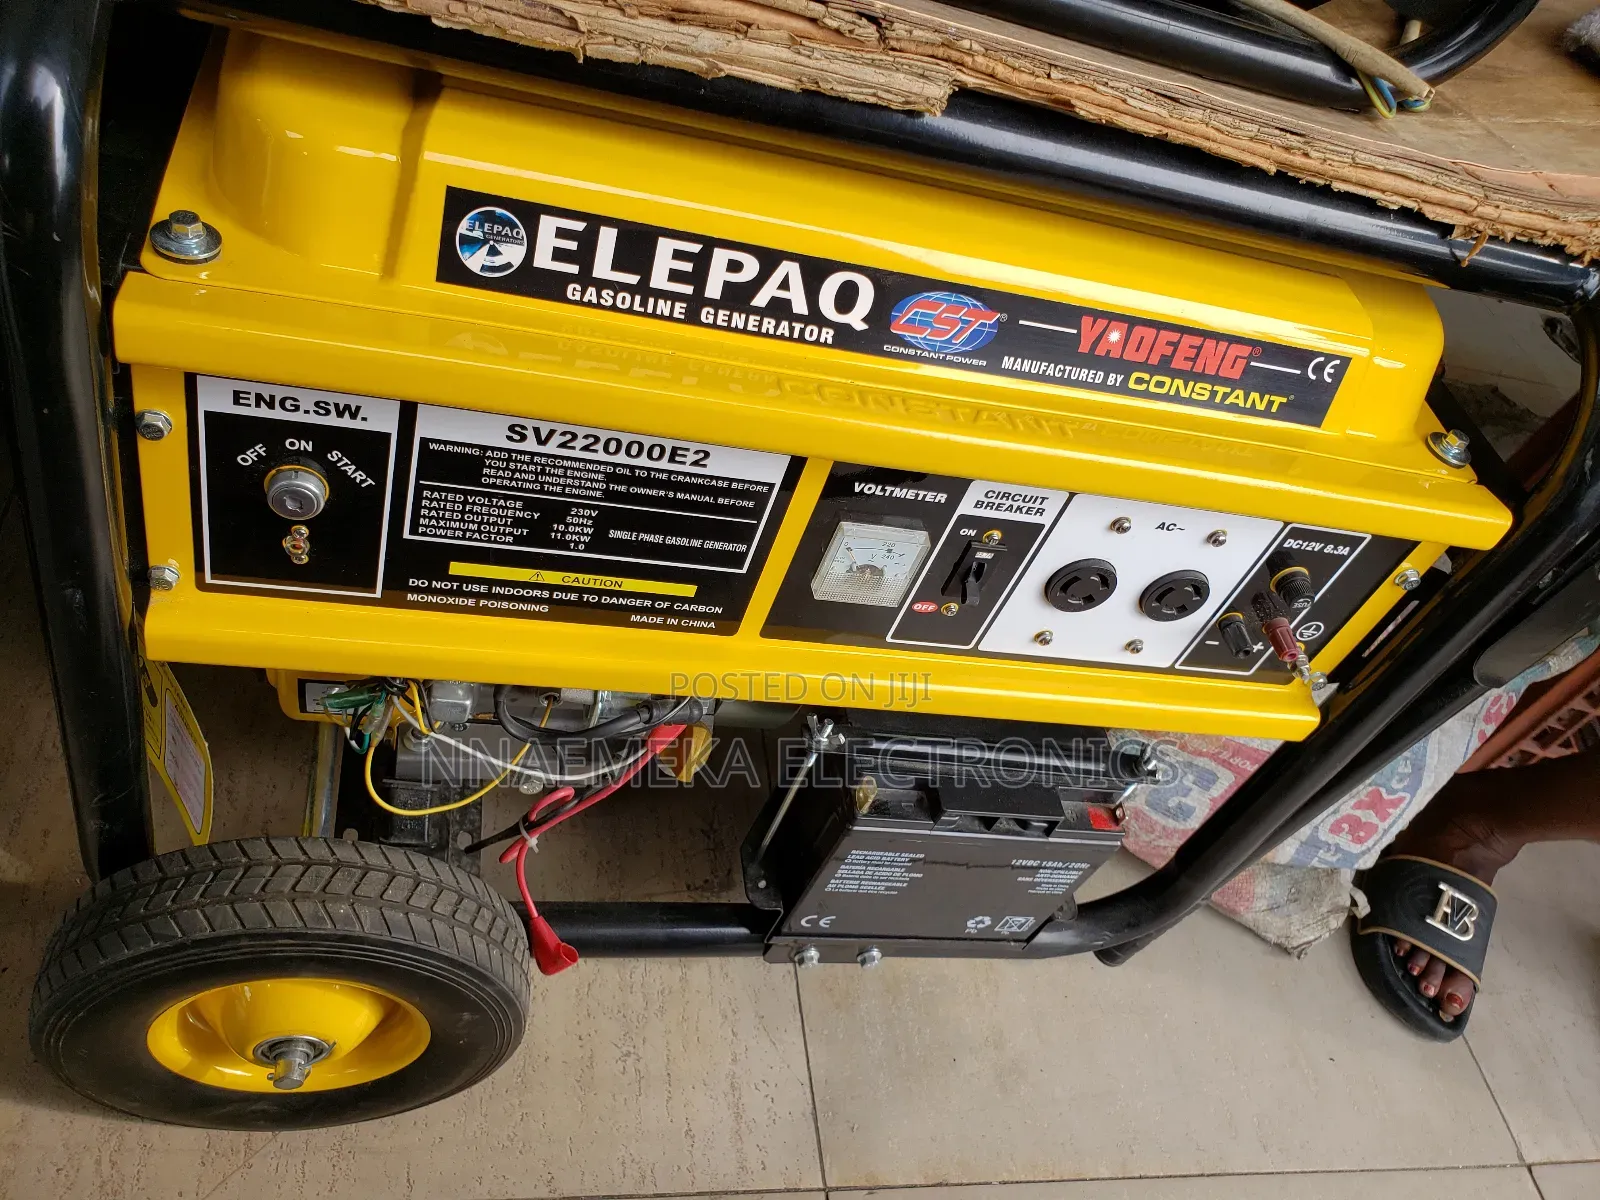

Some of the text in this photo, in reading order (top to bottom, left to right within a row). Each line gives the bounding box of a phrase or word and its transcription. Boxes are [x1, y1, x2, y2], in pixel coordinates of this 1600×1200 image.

[466, 219, 523, 240] ELEPAQ
[532, 213, 876, 331] ELEPAQ
[566, 283, 835, 345] GASOLINE GENERATOR
[890, 299, 1001, 344] CST
[883, 344, 988, 367] CONSTANT POWER
[1077, 315, 1253, 380] YAOFENG
[1001, 355, 1288, 413] MANUFACTURED BY CONSTANT
[232, 389, 368, 422] ENG.SW.
[236, 443, 269, 467] OFF
[284, 438, 313, 452] ON
[505, 423, 712, 469] SV22000E2
[326, 450, 376, 489] START
[429, 442, 770, 493] WARNING: ADD THE RECOMMENDED OIL TO THE CRANKCASE BEFORE
[484, 459, 607, 481] YOU START THE ENGINE.
[481, 477, 605, 498] OPERATING THE ENGINE.
[482, 468, 756, 508] READ AND UNDERSTAND THE OWNER'S MANUAL BEFORE
[853, 481, 948, 504] VOLTMETER
[983, 489, 1050, 506] CIRCUIT
[423, 490, 524, 509] RATED VOLTAGE
[972, 500, 1046, 517] BREAKER
[420, 509, 514, 526] RATED OUTPUT
[421, 500, 541, 520] RATED FREQUENCY
[571, 508, 599, 517] 230V
[419, 518, 530, 536] MAXIMUM OUTPUT
[552, 523, 595, 535] 10.0KW
[566, 516, 594, 526] 50Hz
[418, 527, 514, 544] POWER FACTOR
[550, 532, 591, 543] 11.0KW
[608, 529, 748, 553] SINGLE PHASE GASOLINE GENERATOR
[959, 528, 978, 537] ON
[569, 542, 585, 551] 1.0
[1283, 538, 1351, 556] DC12V 8.3A
[561, 575, 624, 589] CAUTION
[407, 593, 550, 613] MONOXIDE POISONING
[408, 578, 724, 614] DO NOT USE INDOORS DUE TO DANGER OF CARBON
[912, 603, 936, 612] OFF
[630, 614, 716, 629] MADE IN CHINA
[1010, 859, 1040, 867] 12VDC
